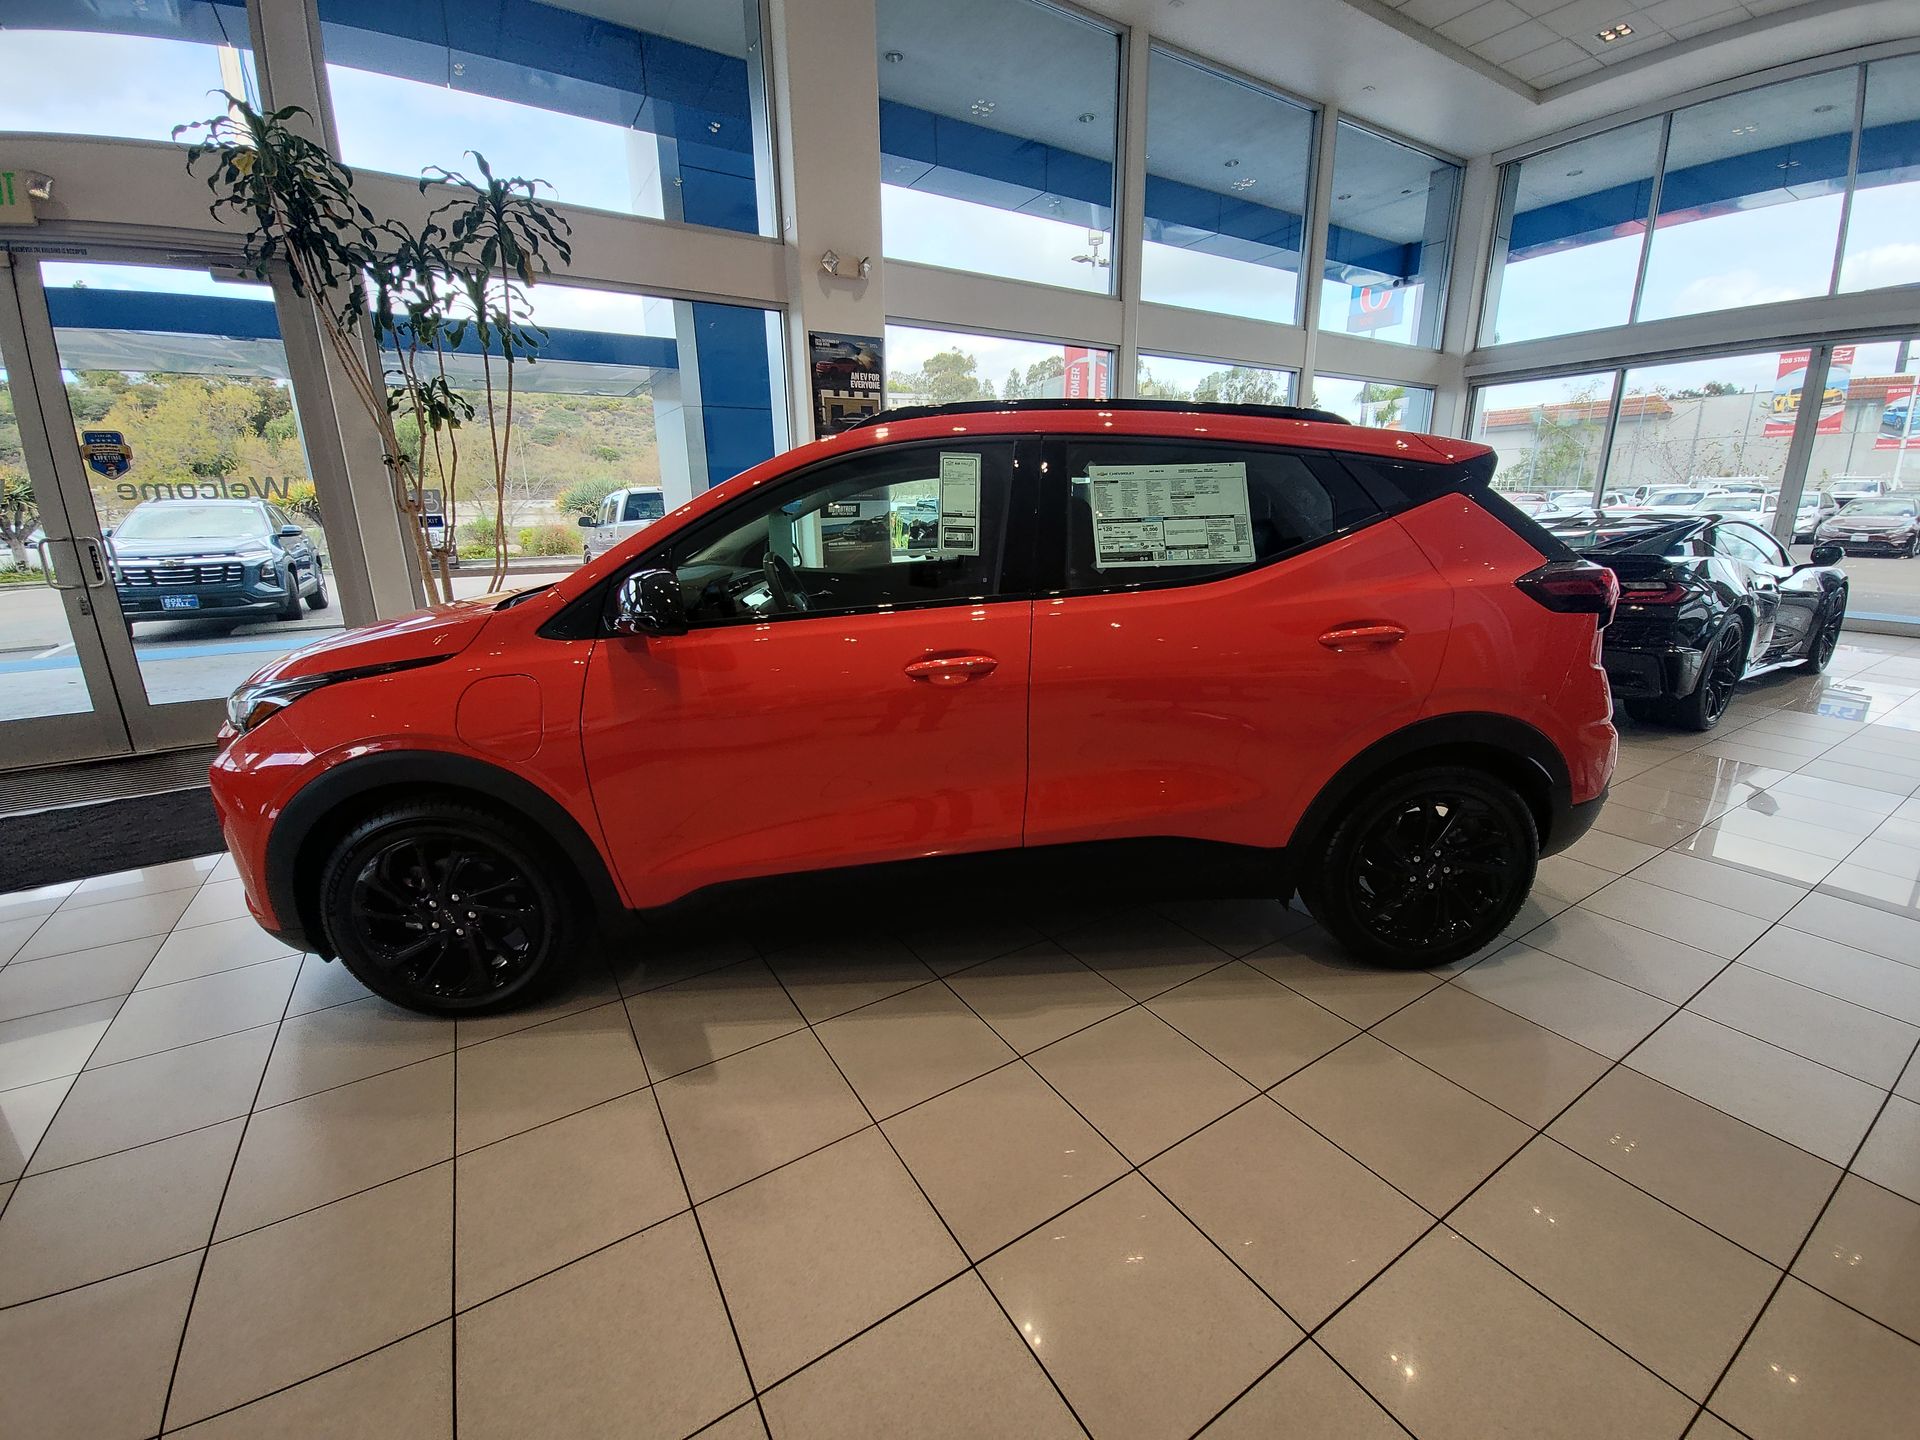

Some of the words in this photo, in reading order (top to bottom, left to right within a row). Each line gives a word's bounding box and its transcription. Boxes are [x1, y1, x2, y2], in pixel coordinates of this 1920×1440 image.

[851, 372, 859, 381] AN
[860, 373, 868, 381] EV
[869, 373, 880, 381] FOR
[850, 381, 880, 389] EVERYONE
